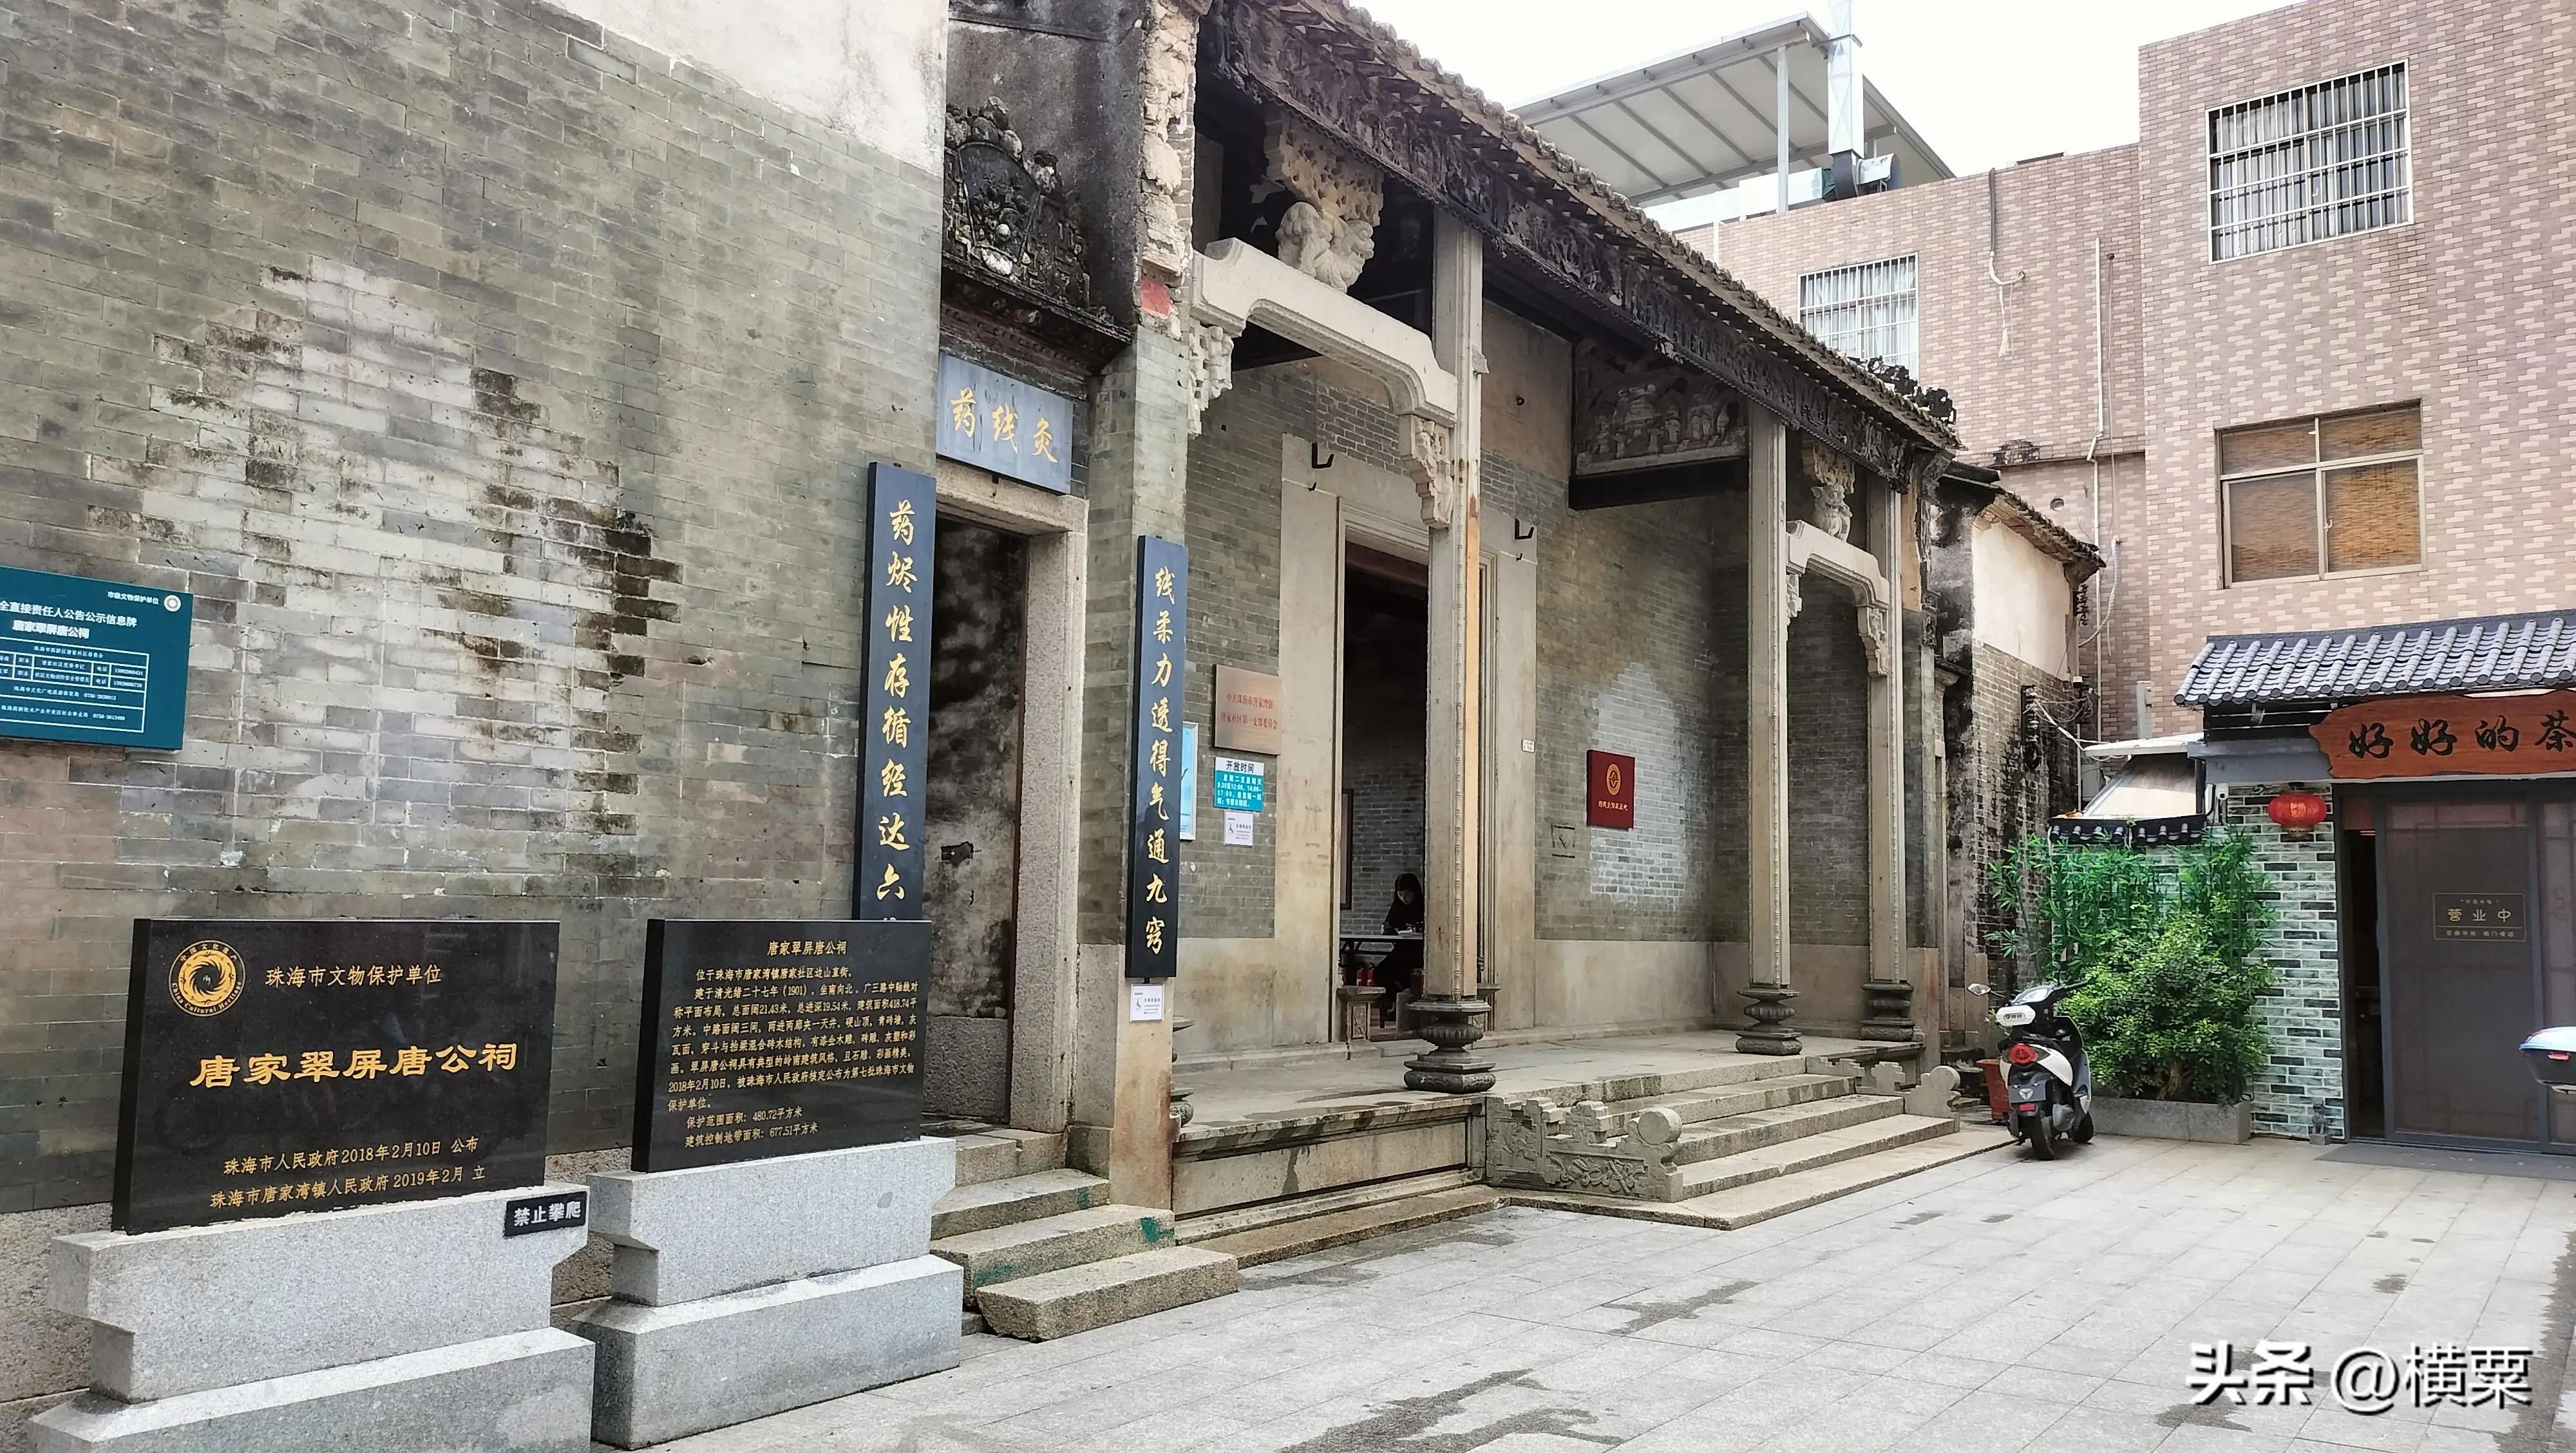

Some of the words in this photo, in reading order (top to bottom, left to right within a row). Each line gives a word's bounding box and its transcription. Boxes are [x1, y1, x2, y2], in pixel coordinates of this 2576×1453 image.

[950, 386, 1058, 464] 药线灸
[12, 619, 90, 640] 唐家翠屏唐公祠
[876, 499, 918, 921] 药烬性存循经达六
[2348, 709, 2576, 759] 好好的茶
[1144, 566, 1177, 956] 线柔力透得气通九窍
[1226, 759, 1255, 774] 开放时间
[2447, 907, 2512, 922] 营业中
[766, 940, 847, 956] 唐家翠屏唐公祠
[265, 964, 442, 989] 珠海市文物保护单位
[189, 1042, 518, 1089] 唐家翠屏唐公祠
[667, 1096, 712, 1113] 保护单位。
[450, 1135, 480, 1154] 公布
[471, 1164, 486, 1181] 立
[513, 1200, 582, 1228] 禁止攀爬
